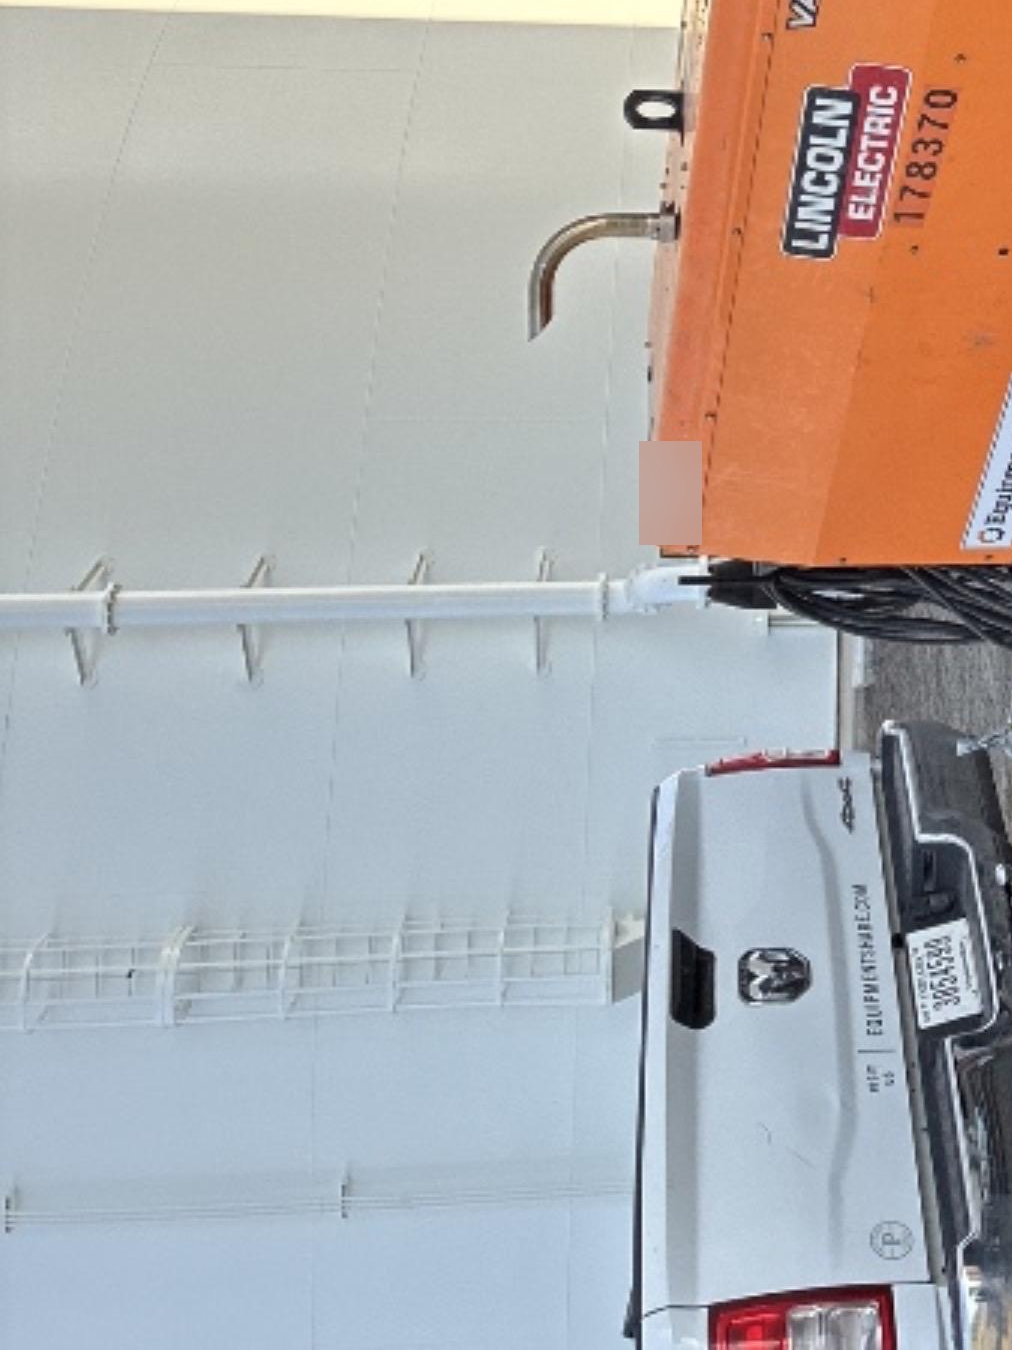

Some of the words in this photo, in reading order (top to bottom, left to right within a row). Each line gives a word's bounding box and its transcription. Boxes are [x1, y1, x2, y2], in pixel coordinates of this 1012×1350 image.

[790, 97, 853, 251] LINCOLN
[847, 85, 899, 221] ELECTRIC
[893, 89, 958, 224] 178370
